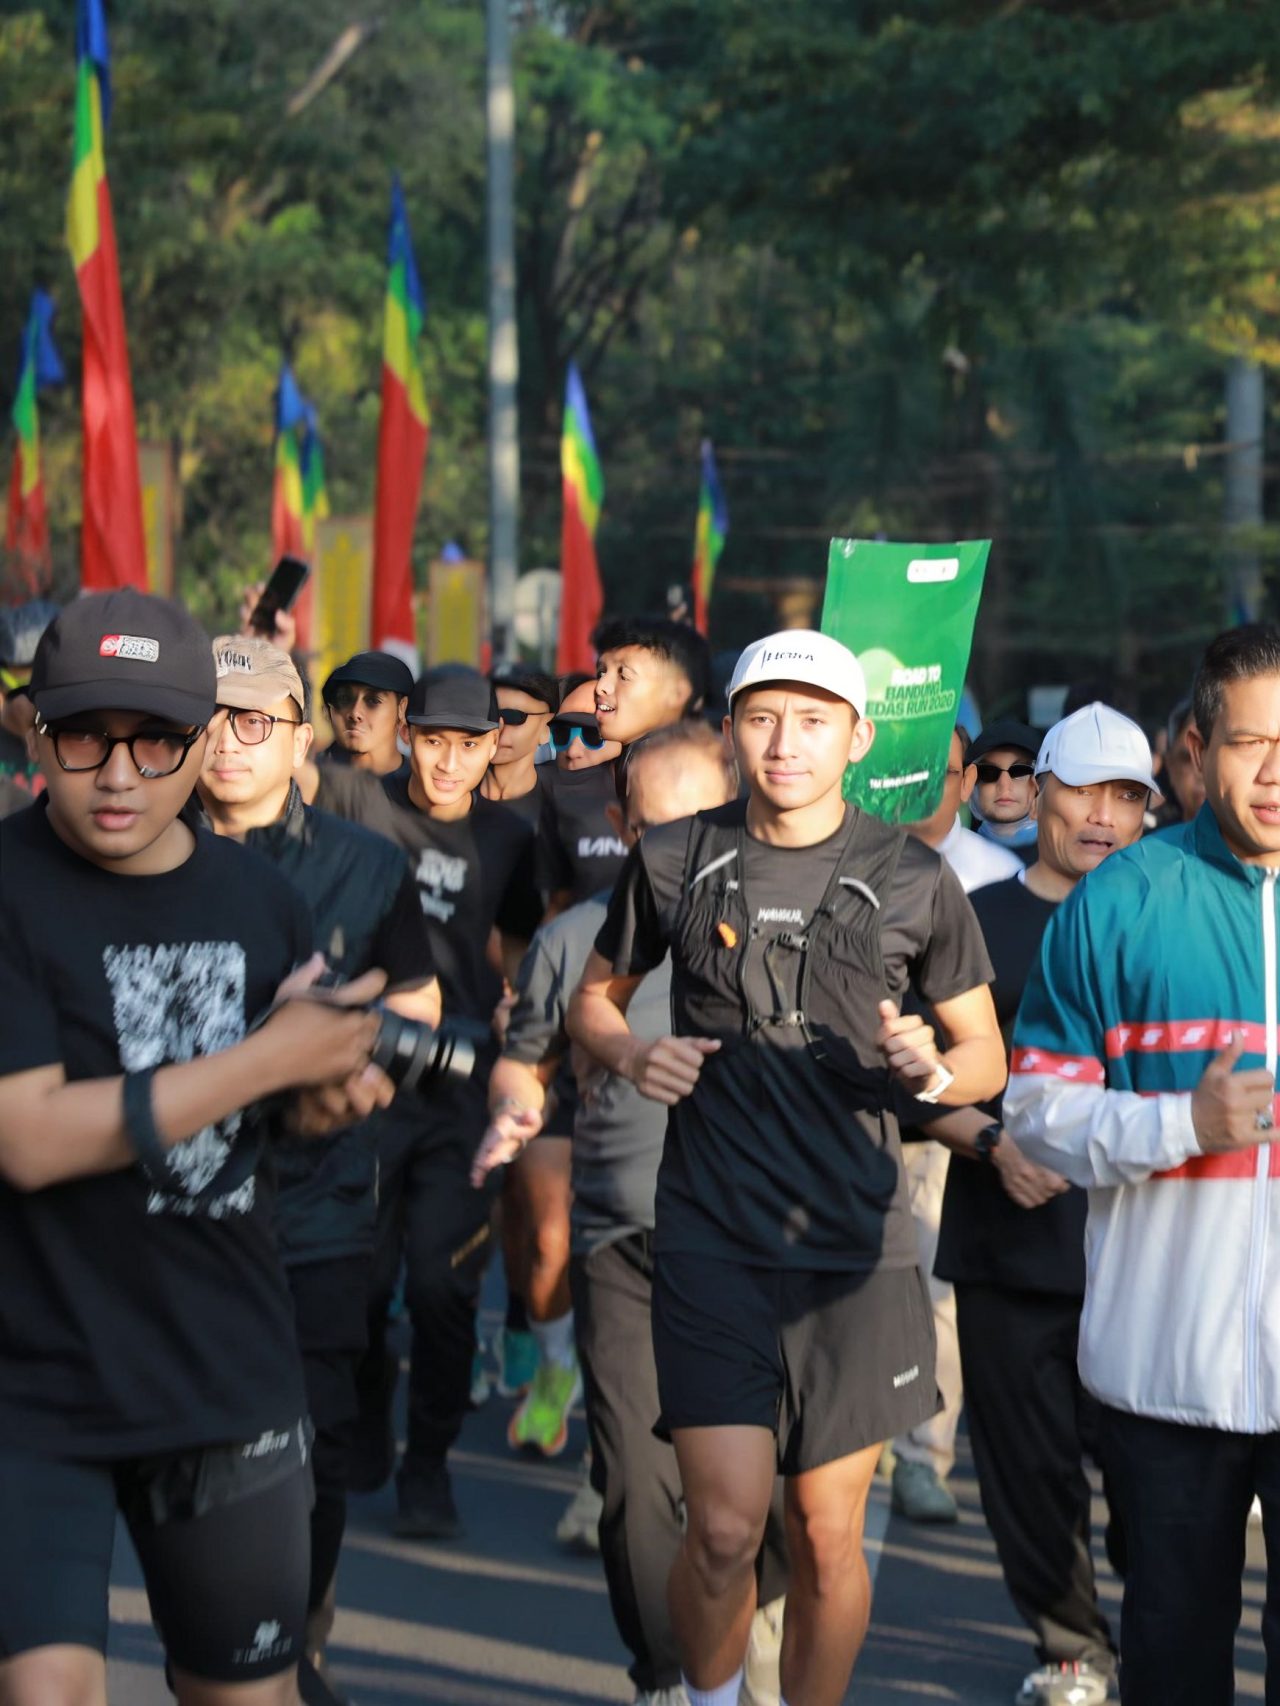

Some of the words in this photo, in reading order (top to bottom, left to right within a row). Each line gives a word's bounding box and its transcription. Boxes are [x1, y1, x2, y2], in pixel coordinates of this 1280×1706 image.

[891, 667, 926, 686] ROAD
[927, 664, 941, 682] TO
[865, 700, 903, 717] EDAS
[906, 697, 929, 714] RUN
